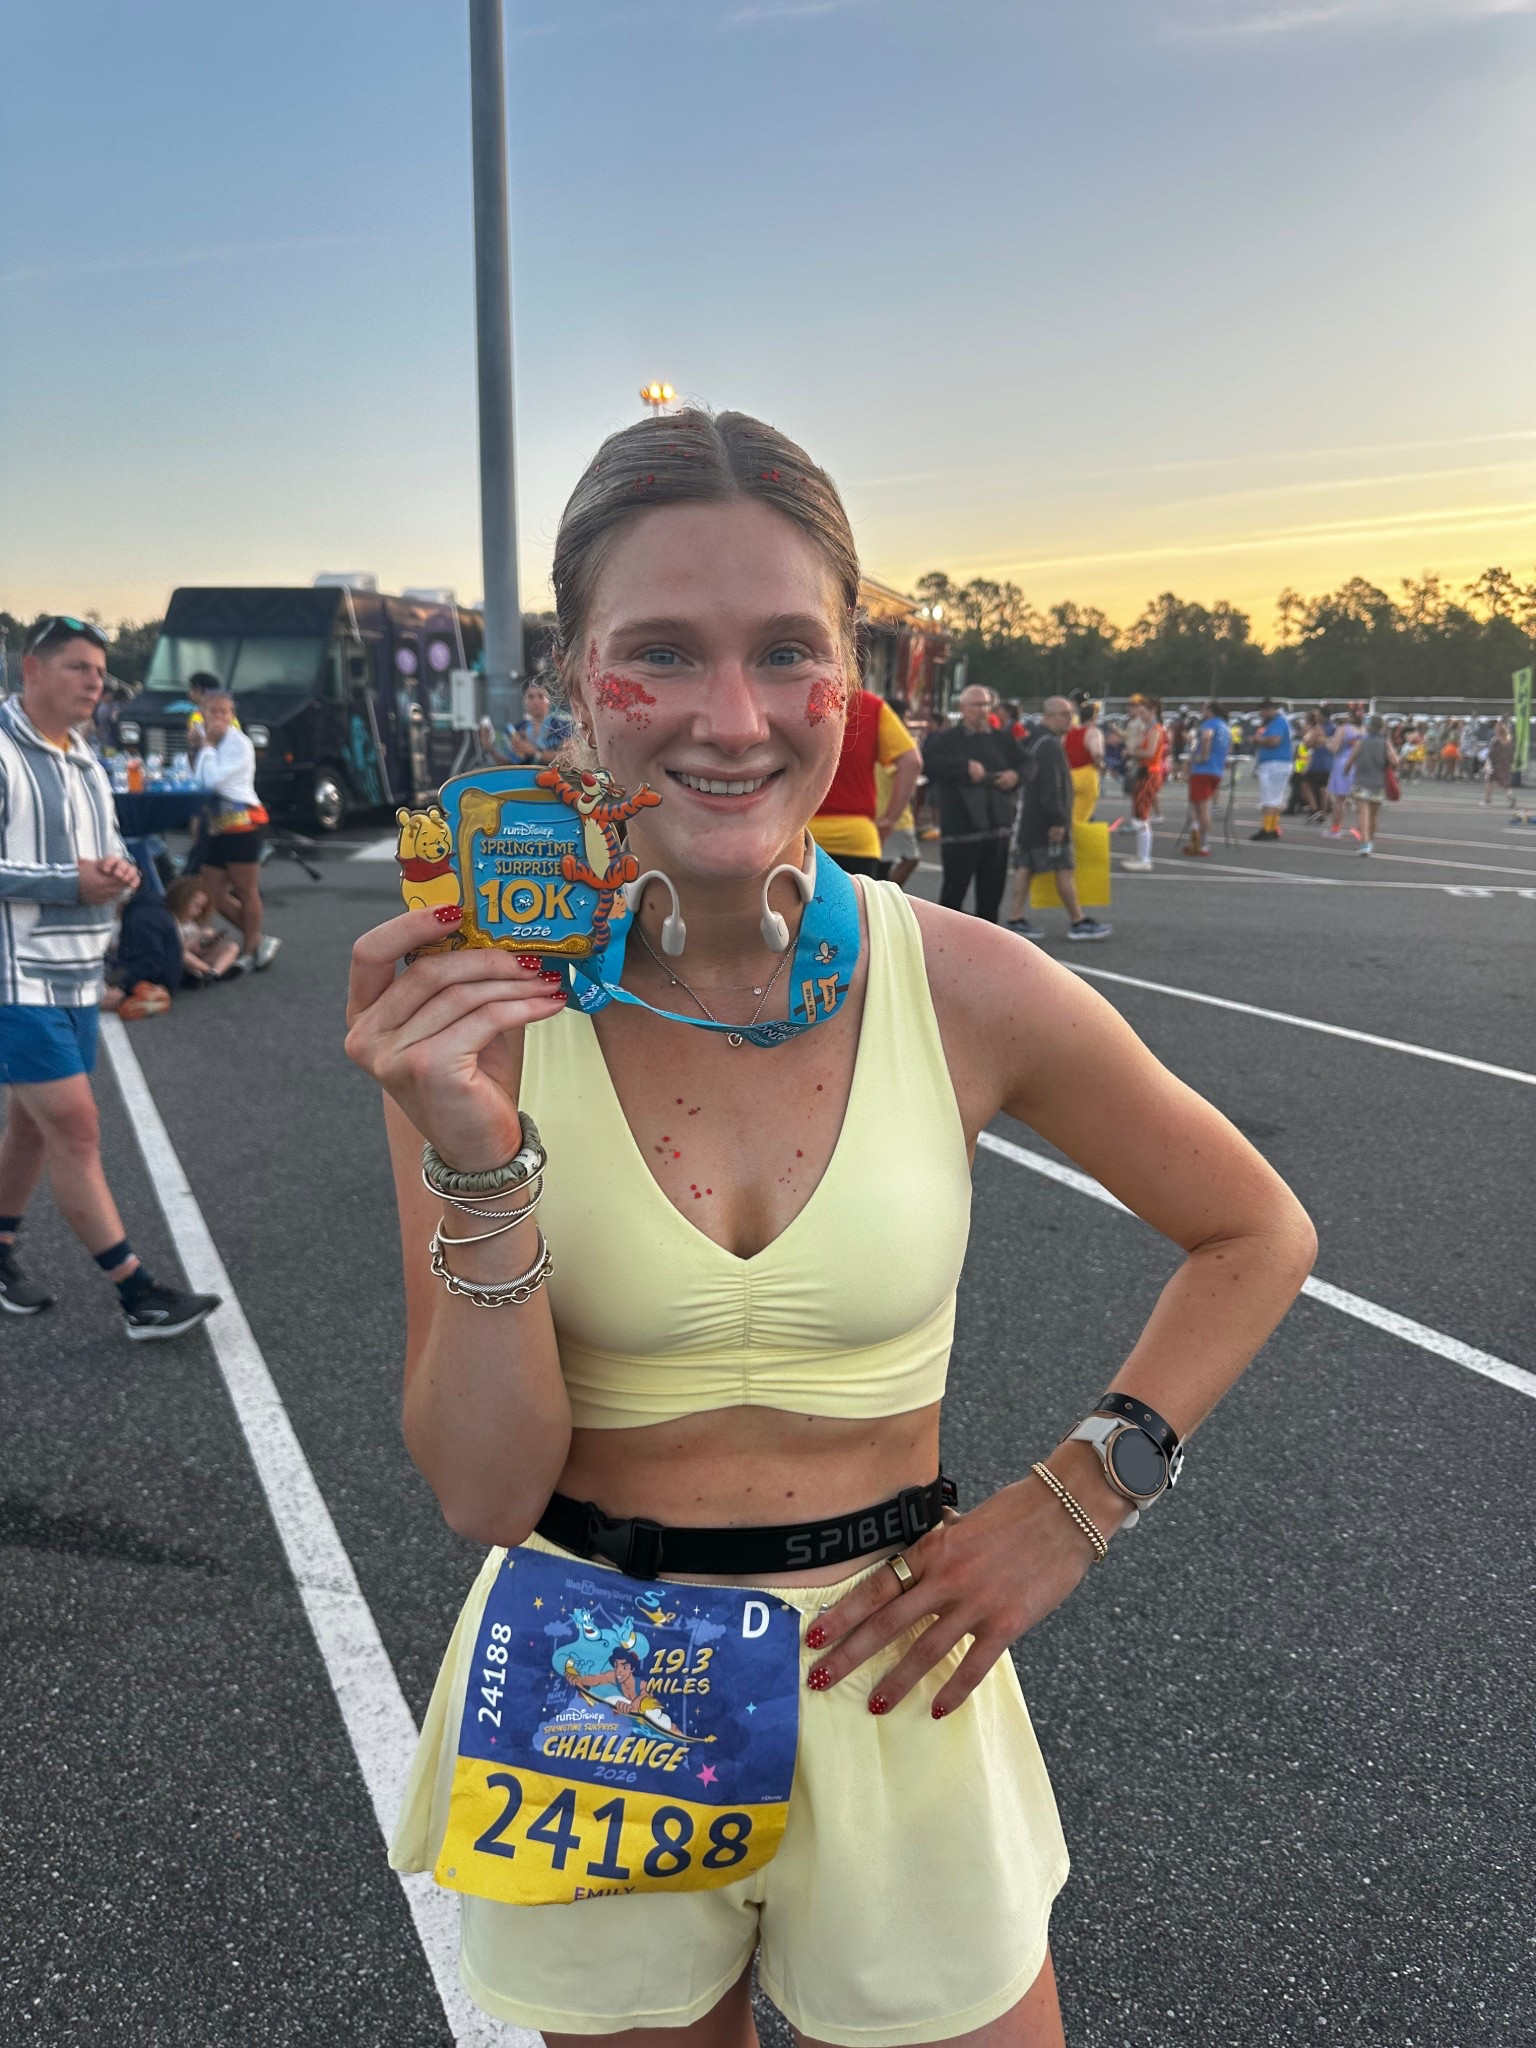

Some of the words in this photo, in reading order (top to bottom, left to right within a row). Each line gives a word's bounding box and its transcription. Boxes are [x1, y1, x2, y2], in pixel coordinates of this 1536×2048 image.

[481, 839, 577, 858] SPRINGTIME
[495, 859, 563, 877] SURPRISE
[478, 879, 576, 924] 10K
[511, 926, 552, 937] 2026
[785, 1496, 931, 1565] SPIBEL
[742, 1600, 770, 1639] D
[649, 1647, 714, 1674] 19.3
[478, 1623, 512, 1728] 24188
[646, 1677, 711, 1695] MILES
[543, 1723, 582, 1735] SPRINGTIME
[583, 1722, 620, 1732] SURPRISE
[542, 1734, 690, 1772] CHALLENGE
[593, 1766, 638, 1783] 2026
[473, 1772, 752, 1880] 24188
